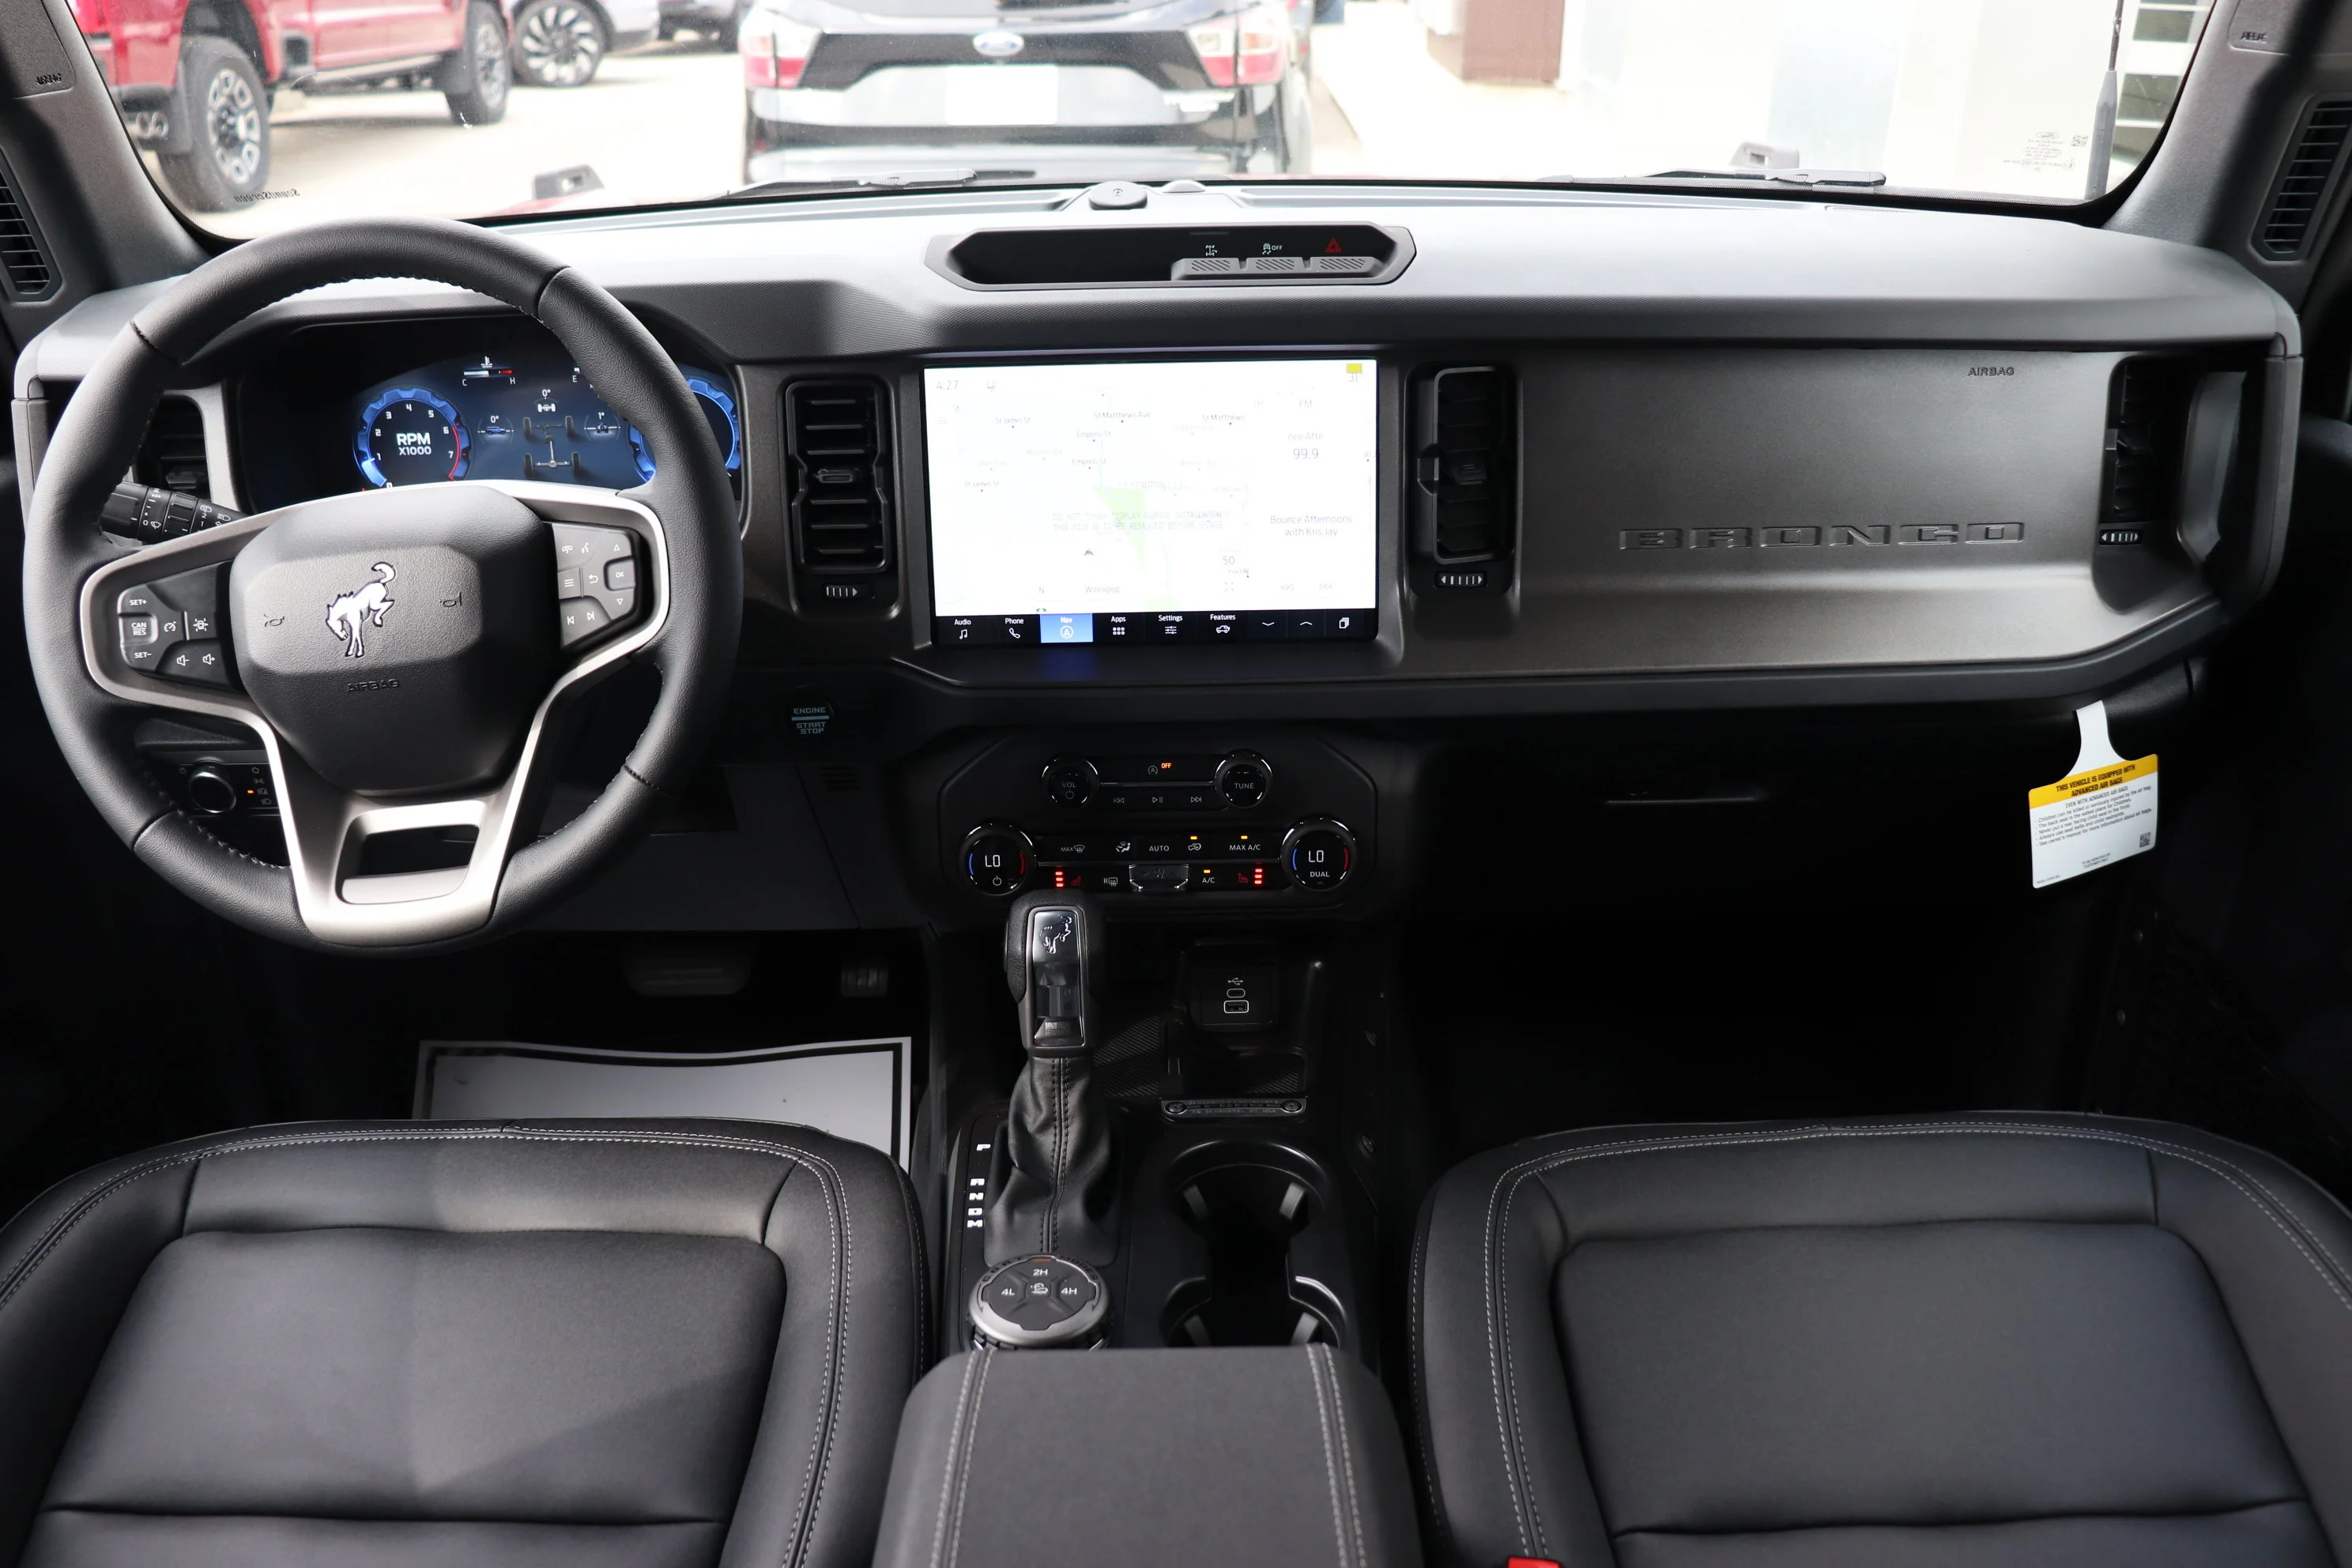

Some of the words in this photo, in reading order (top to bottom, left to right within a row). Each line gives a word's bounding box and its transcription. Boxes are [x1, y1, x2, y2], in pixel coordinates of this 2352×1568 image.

[1968, 367, 2015, 376] AIRBAG
[936, 380, 959, 390] 4:27
[1298, 399, 1312, 409] FM
[397, 432, 431, 445] RPM
[398, 446, 432, 456] X1000
[1293, 447, 1319, 459] 99.9
[1270, 515, 1302, 524] Bounce
[1304, 514, 1352, 524] Afternoons
[1285, 527, 1304, 536] with
[1306, 527, 1322, 536] Kris
[1324, 527, 1338, 538] Jay
[1619, 522, 2025, 550] BRONCO
[1223, 556, 1235, 565] 50
[1084, 585, 1121, 596] Winnipeg
[347, 679, 401, 692] AIRBAG
[2069, 777, 2091, 789] VEHICLE
[2098, 769, 2123, 781] EQUIPPED
[2123, 764, 2135, 774] WITH
[2071, 785, 2099, 797] ADVANCED
[2109, 777, 2124, 786] BAGS
[2065, 800, 2076, 808] EVEN
[2089, 791, 2110, 801] ADVANCED
[2038, 814, 2056, 823] Children
[2072, 805, 2085, 813] killed
[1308, 850, 1325, 863] LO
